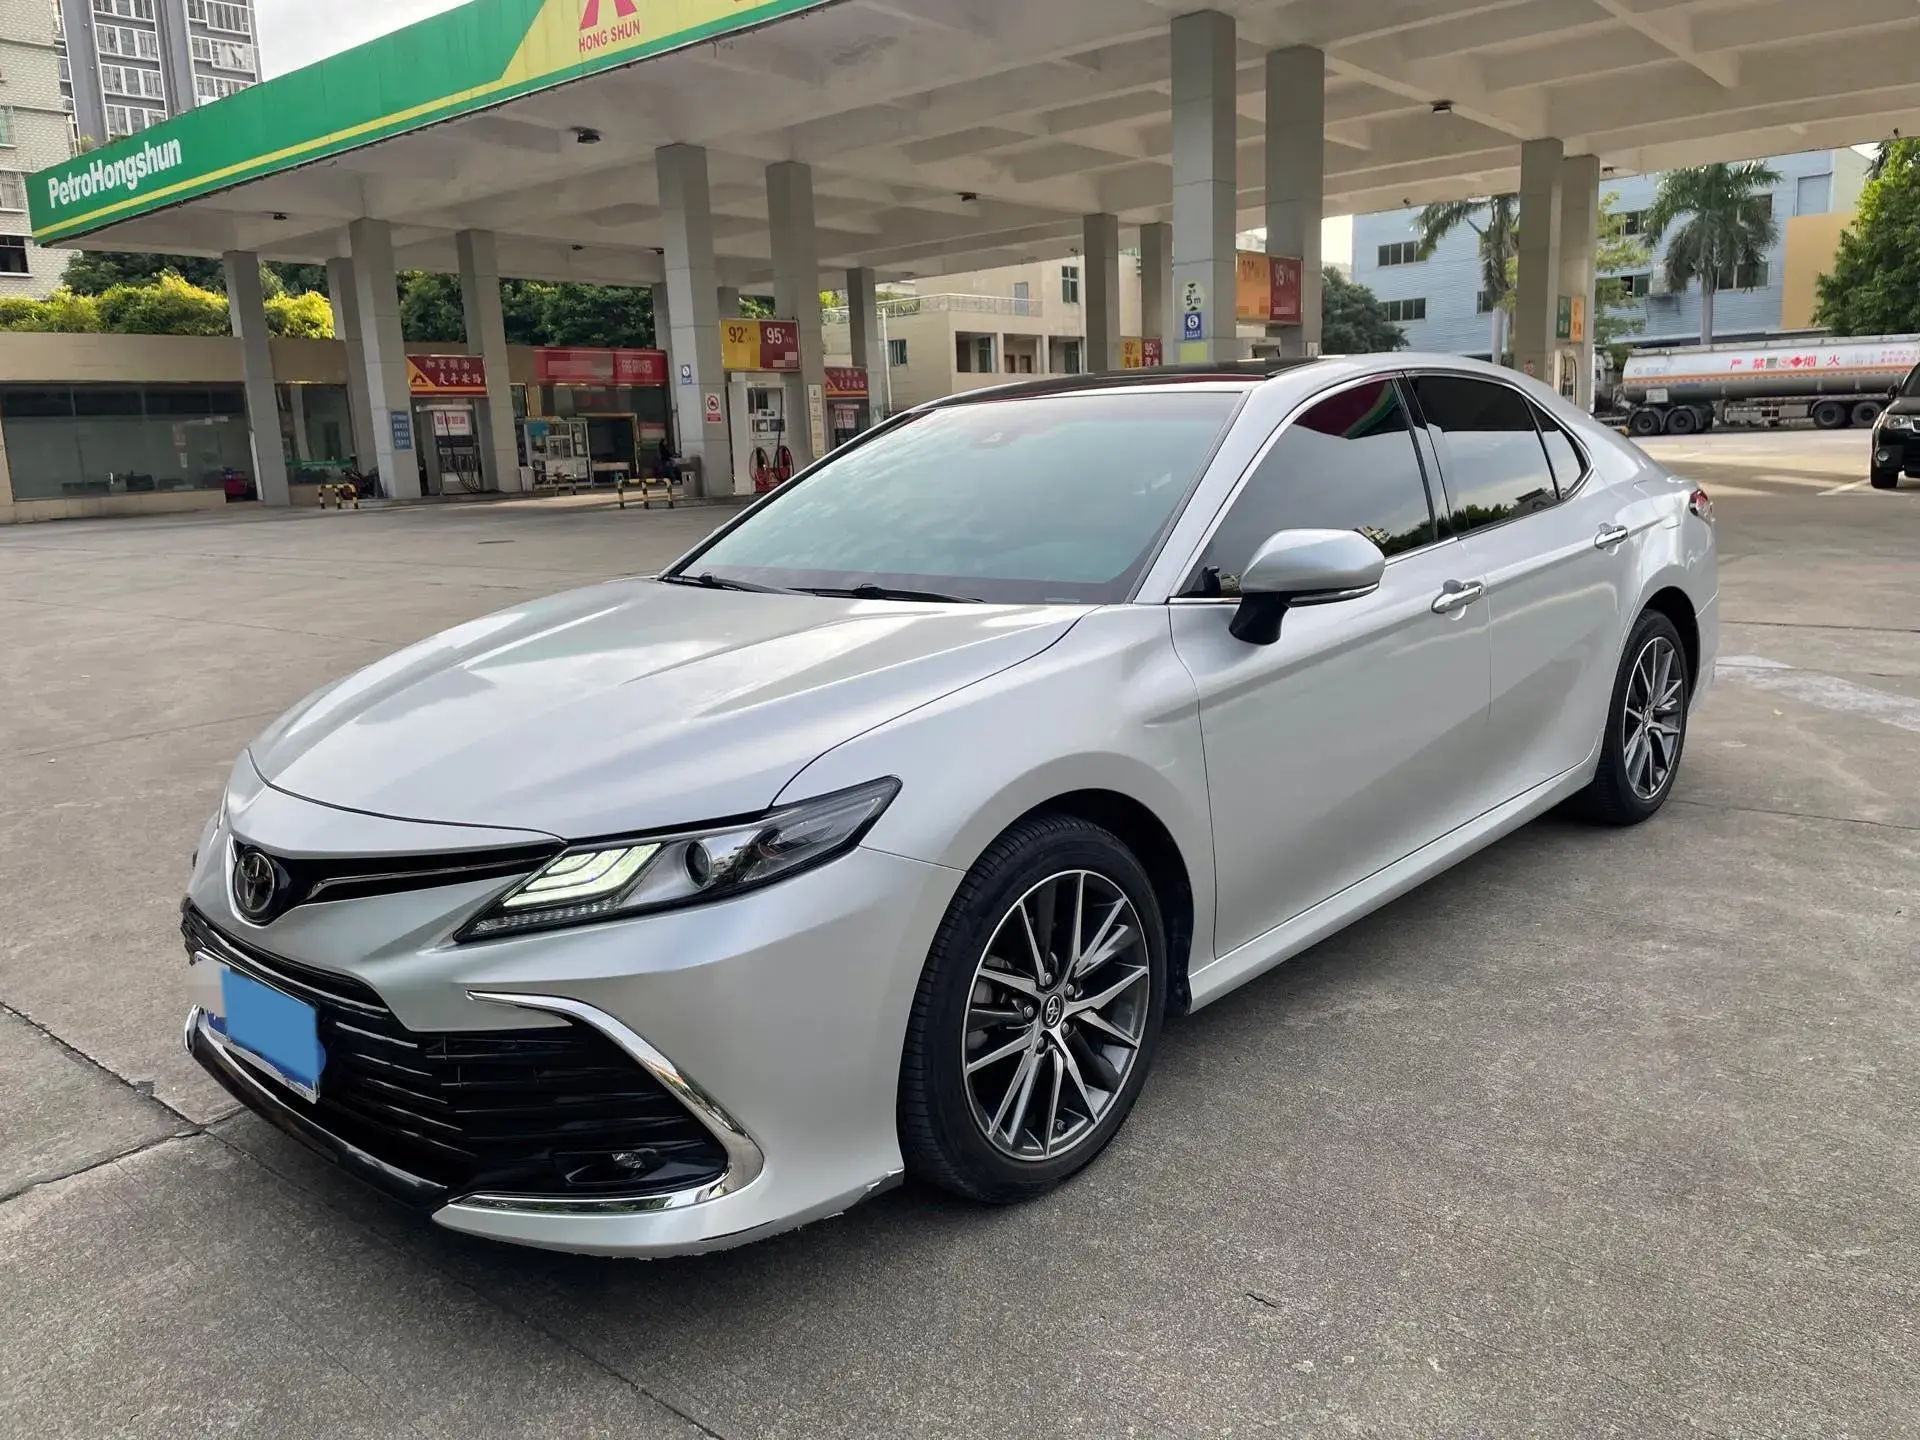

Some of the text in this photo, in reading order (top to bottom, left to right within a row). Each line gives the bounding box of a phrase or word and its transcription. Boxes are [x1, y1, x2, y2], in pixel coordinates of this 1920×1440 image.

[578, 19, 640, 53] HONG SHUN
[47, 138, 183, 209] PetroHongshun
